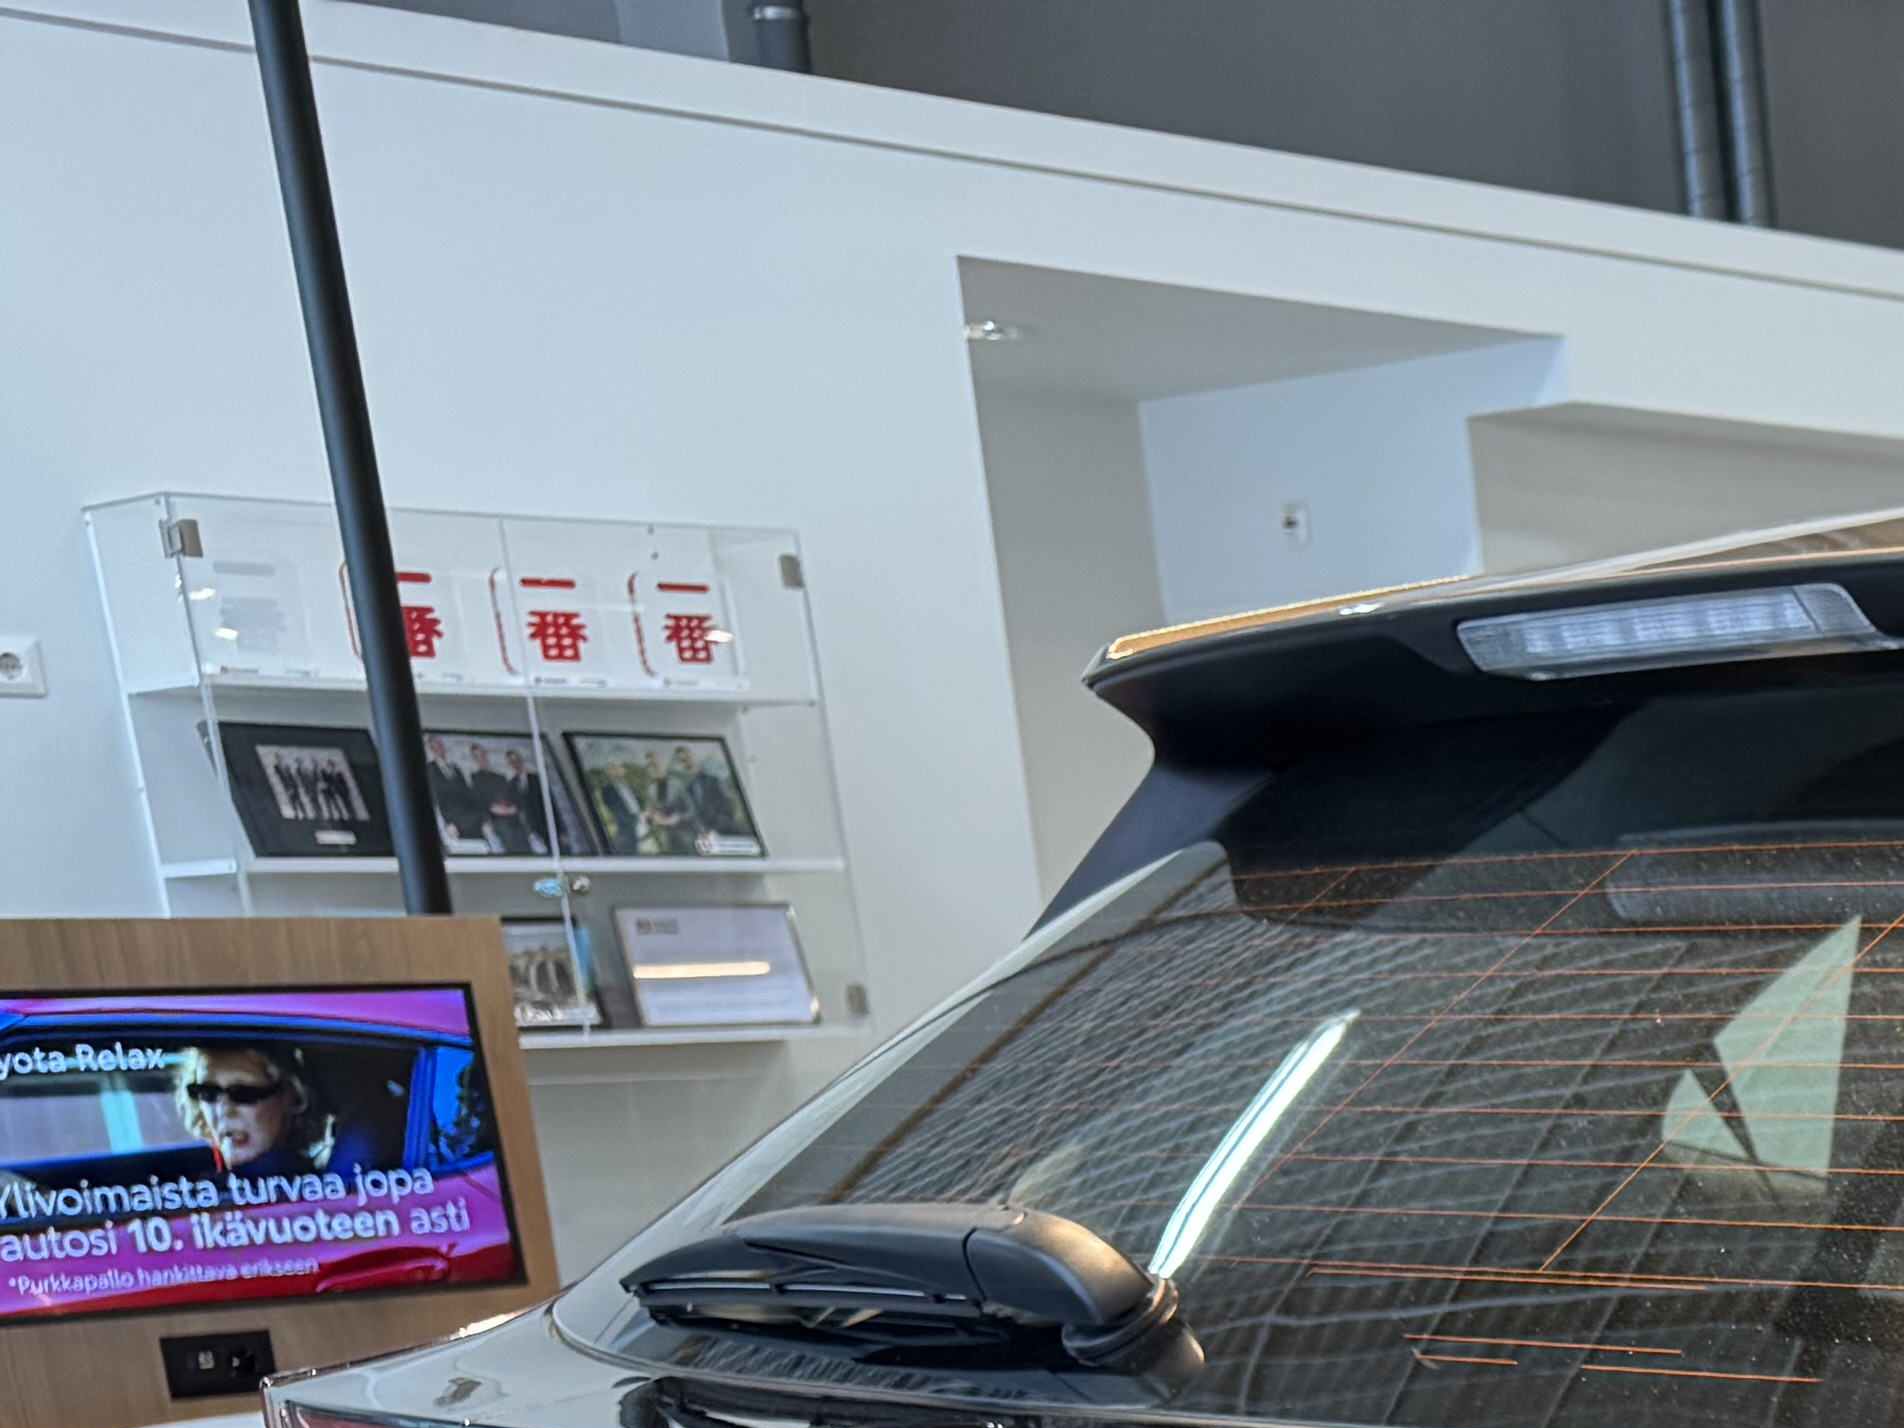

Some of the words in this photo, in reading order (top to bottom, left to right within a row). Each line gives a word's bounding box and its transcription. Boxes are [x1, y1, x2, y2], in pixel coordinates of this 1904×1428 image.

[75, 1041, 165, 1072] Relax
[227, 1171, 346, 1205] turvaa
[354, 1162, 435, 1207] jopa
[0, 1219, 118, 1262] autosi
[127, 1216, 184, 1253] 10.
[190, 1207, 401, 1248] ikävuoteen
[410, 1197, 471, 1235] asti
